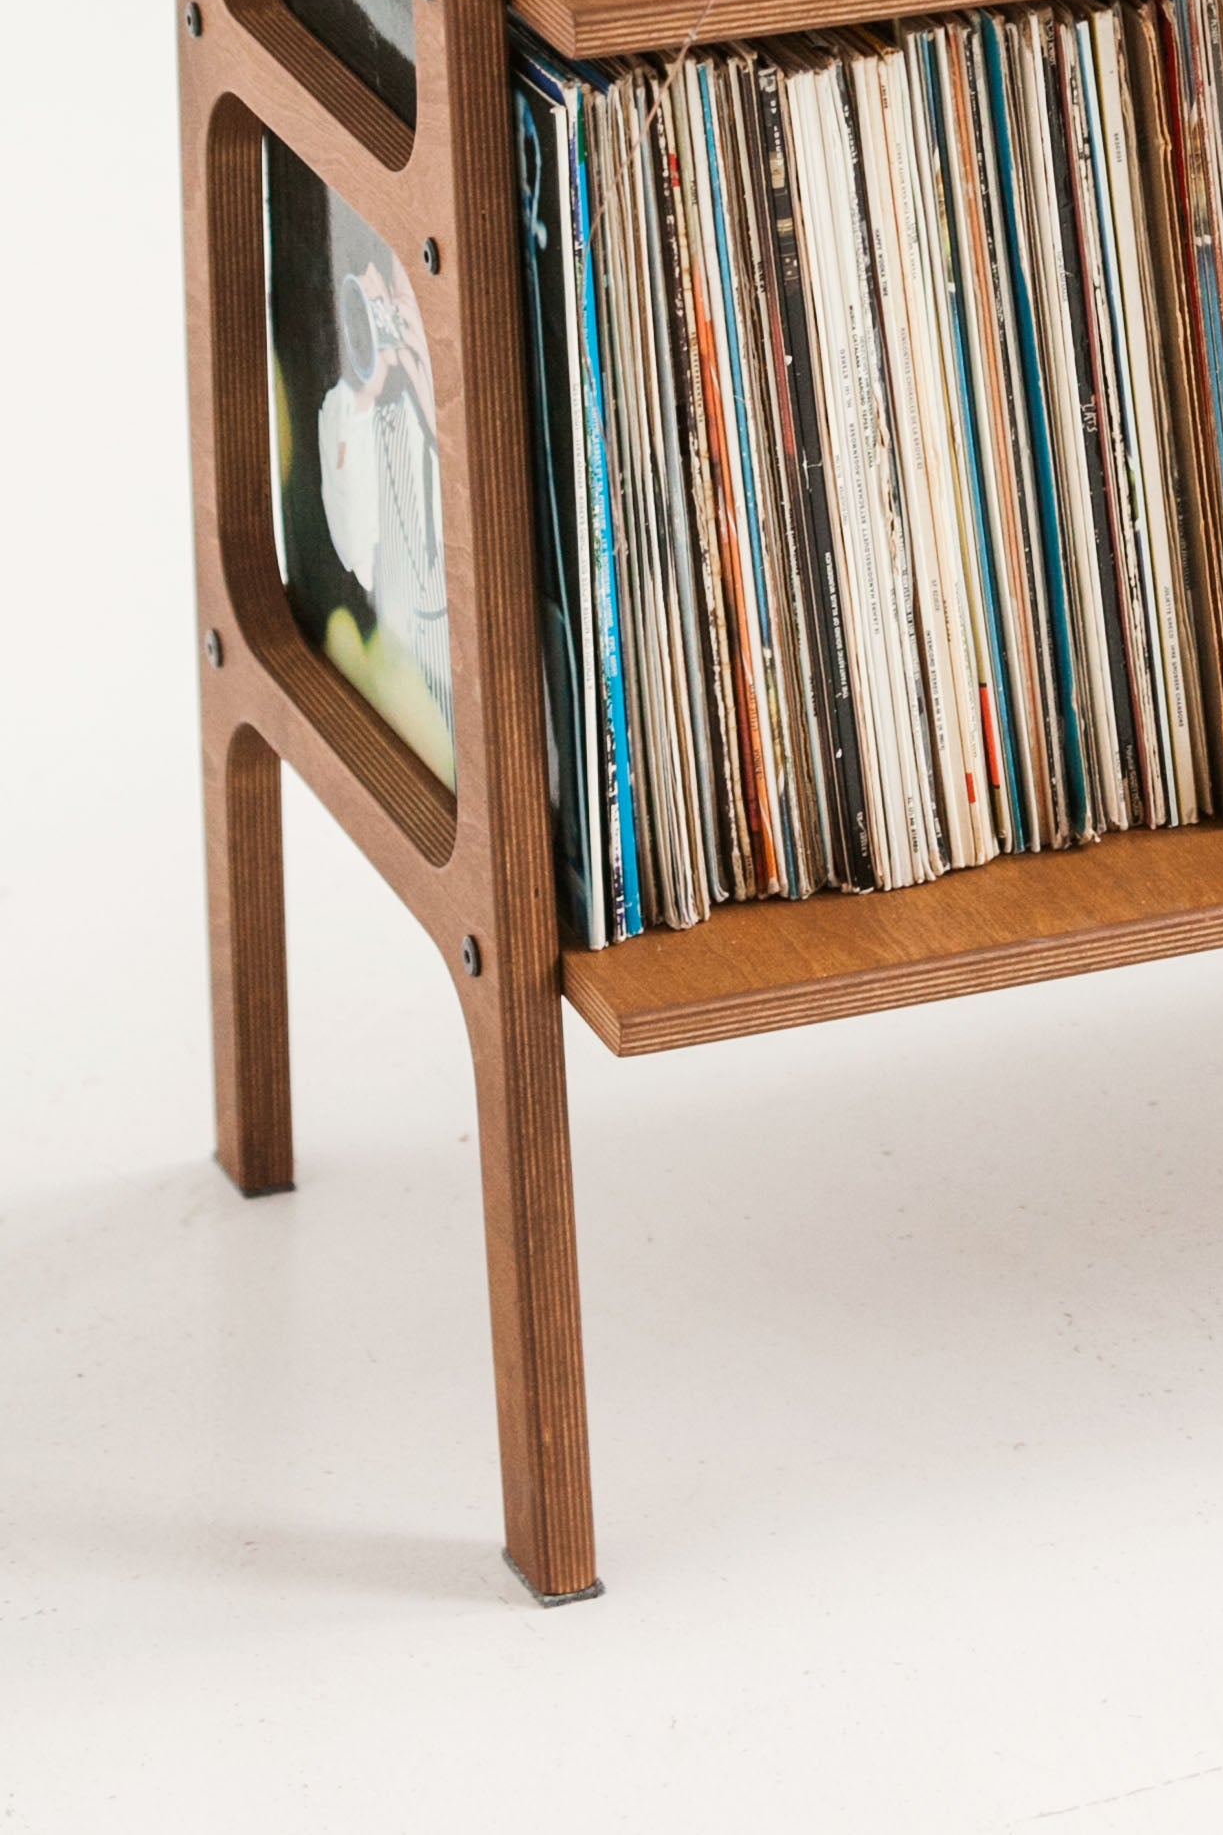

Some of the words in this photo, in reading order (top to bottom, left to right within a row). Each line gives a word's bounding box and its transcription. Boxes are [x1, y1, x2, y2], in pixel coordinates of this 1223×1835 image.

[874, 228, 882, 250] HAPPY
[881, 280, 889, 297] TIME
[824, 551, 835, 594] WUNDERLICH
[829, 594, 838, 616] KLAUS
[833, 626, 843, 649] SOUND
[836, 650, 847, 685] FANTASTIC
